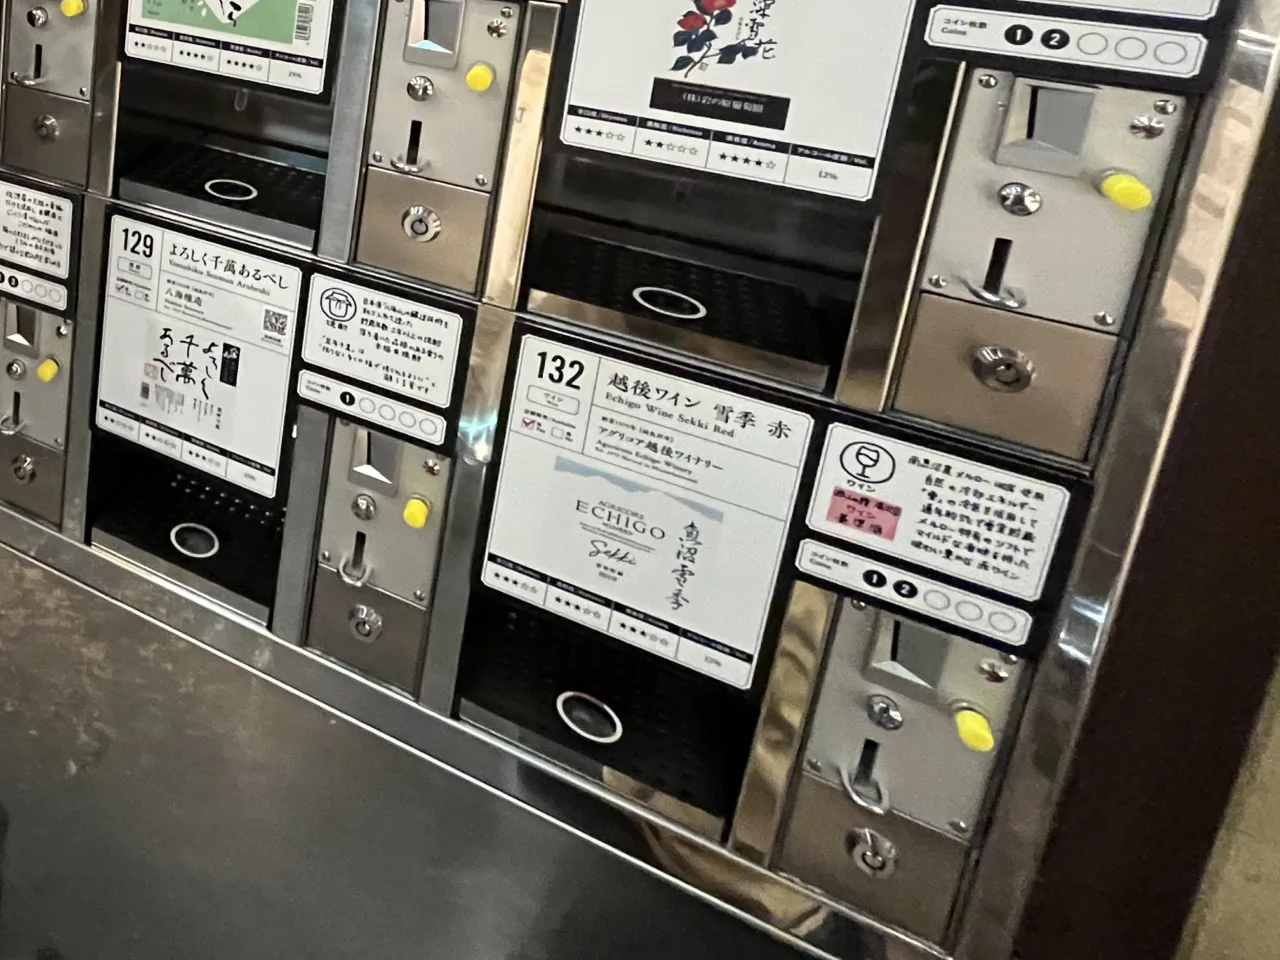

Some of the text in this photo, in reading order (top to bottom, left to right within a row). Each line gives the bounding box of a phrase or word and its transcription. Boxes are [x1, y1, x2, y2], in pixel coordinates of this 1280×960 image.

[122, 227, 154, 258] 129
[169, 243, 289, 290] よろしく千萬あるべし
[536, 351, 585, 391] 132
[605, 392, 642, 411] Echigo
[645, 402, 675, 419] Wine
[677, 411, 712, 429] Sekki
[713, 422, 735, 439] Red
[608, 372, 793, 440] 越後ワイン 雪季 赤
[597, 425, 724, 471] アグリコア越後ワイナリー
[846, 479, 876, 493] ワイン
[576, 499, 666, 540] ECHIGO
